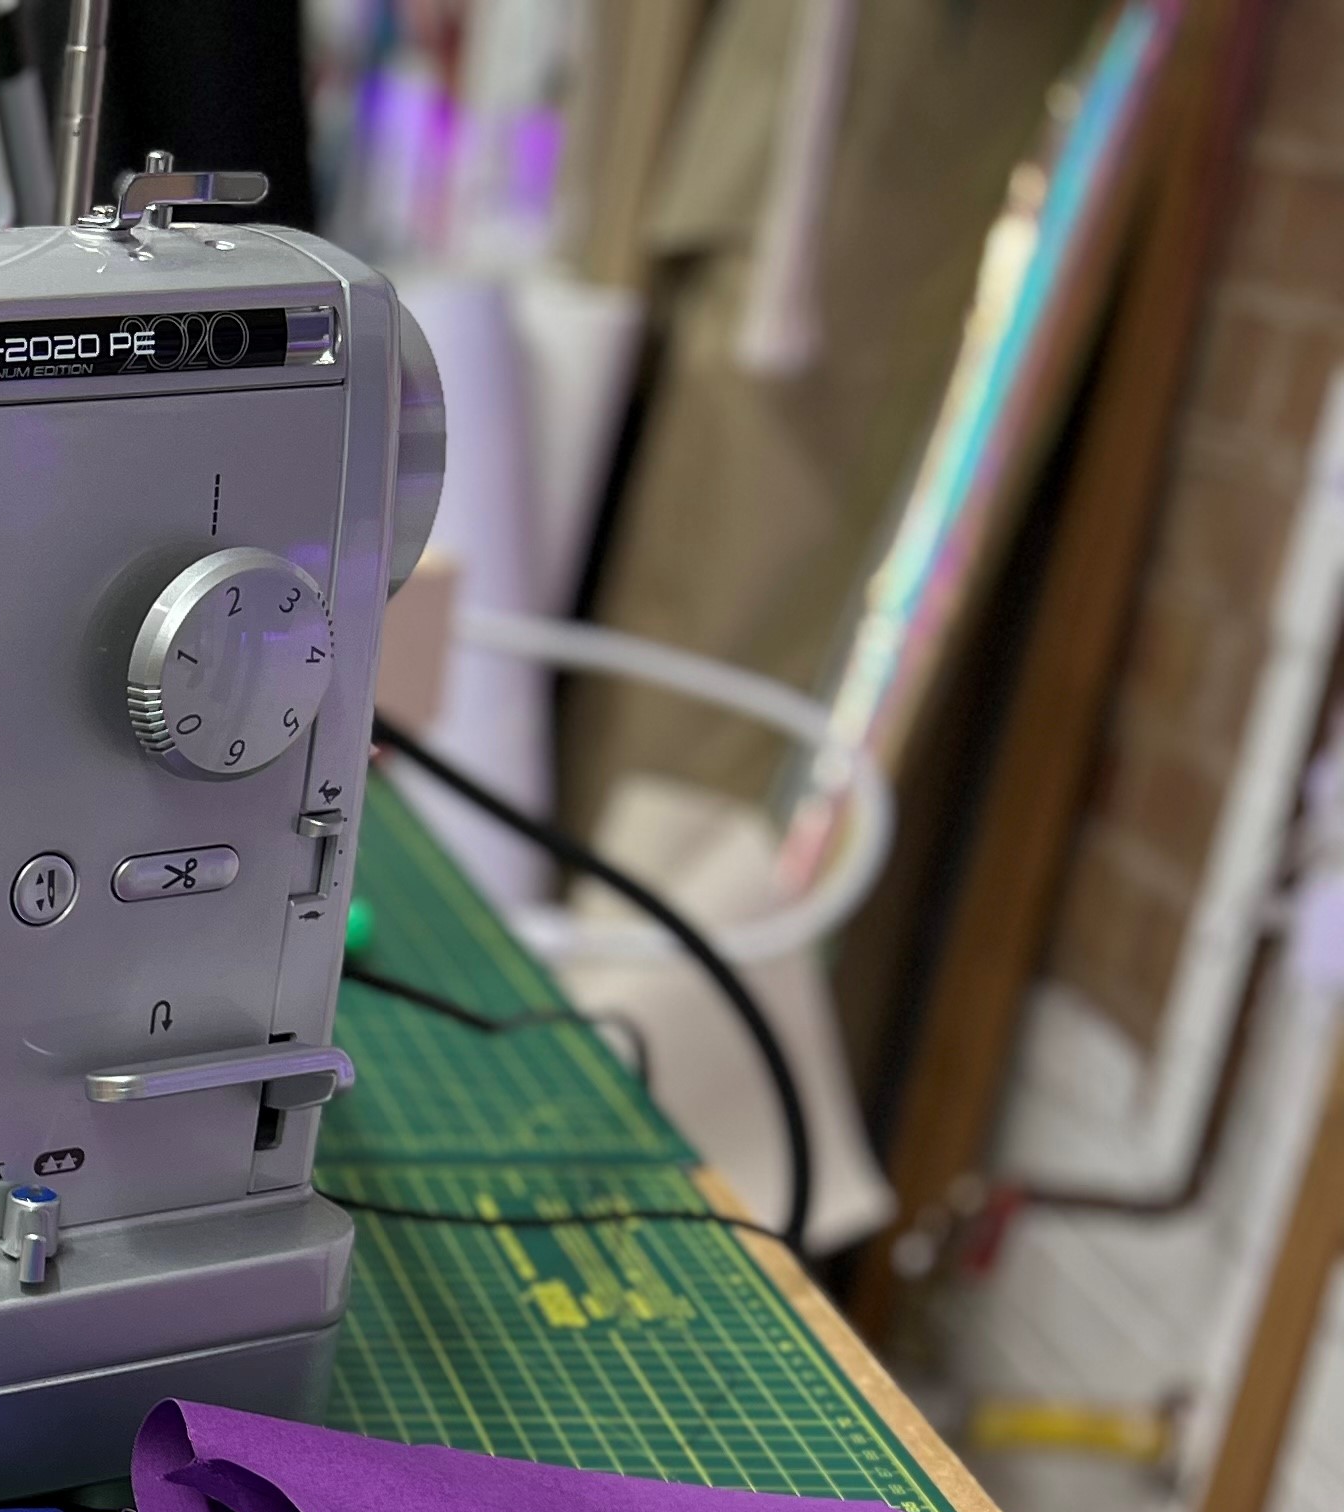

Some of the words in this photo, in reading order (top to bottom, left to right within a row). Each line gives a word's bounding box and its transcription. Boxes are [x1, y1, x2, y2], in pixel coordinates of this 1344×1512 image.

[109, 331, 155, 356] PE
[33, 363, 94, 378] EDITION
[226, 586, 242, 617] 2
[279, 588, 301, 613] 3
[177, 650, 198, 664] 1
[305, 646, 326, 664] 4
[176, 714, 202, 735] 0
[283, 708, 299, 736] 5
